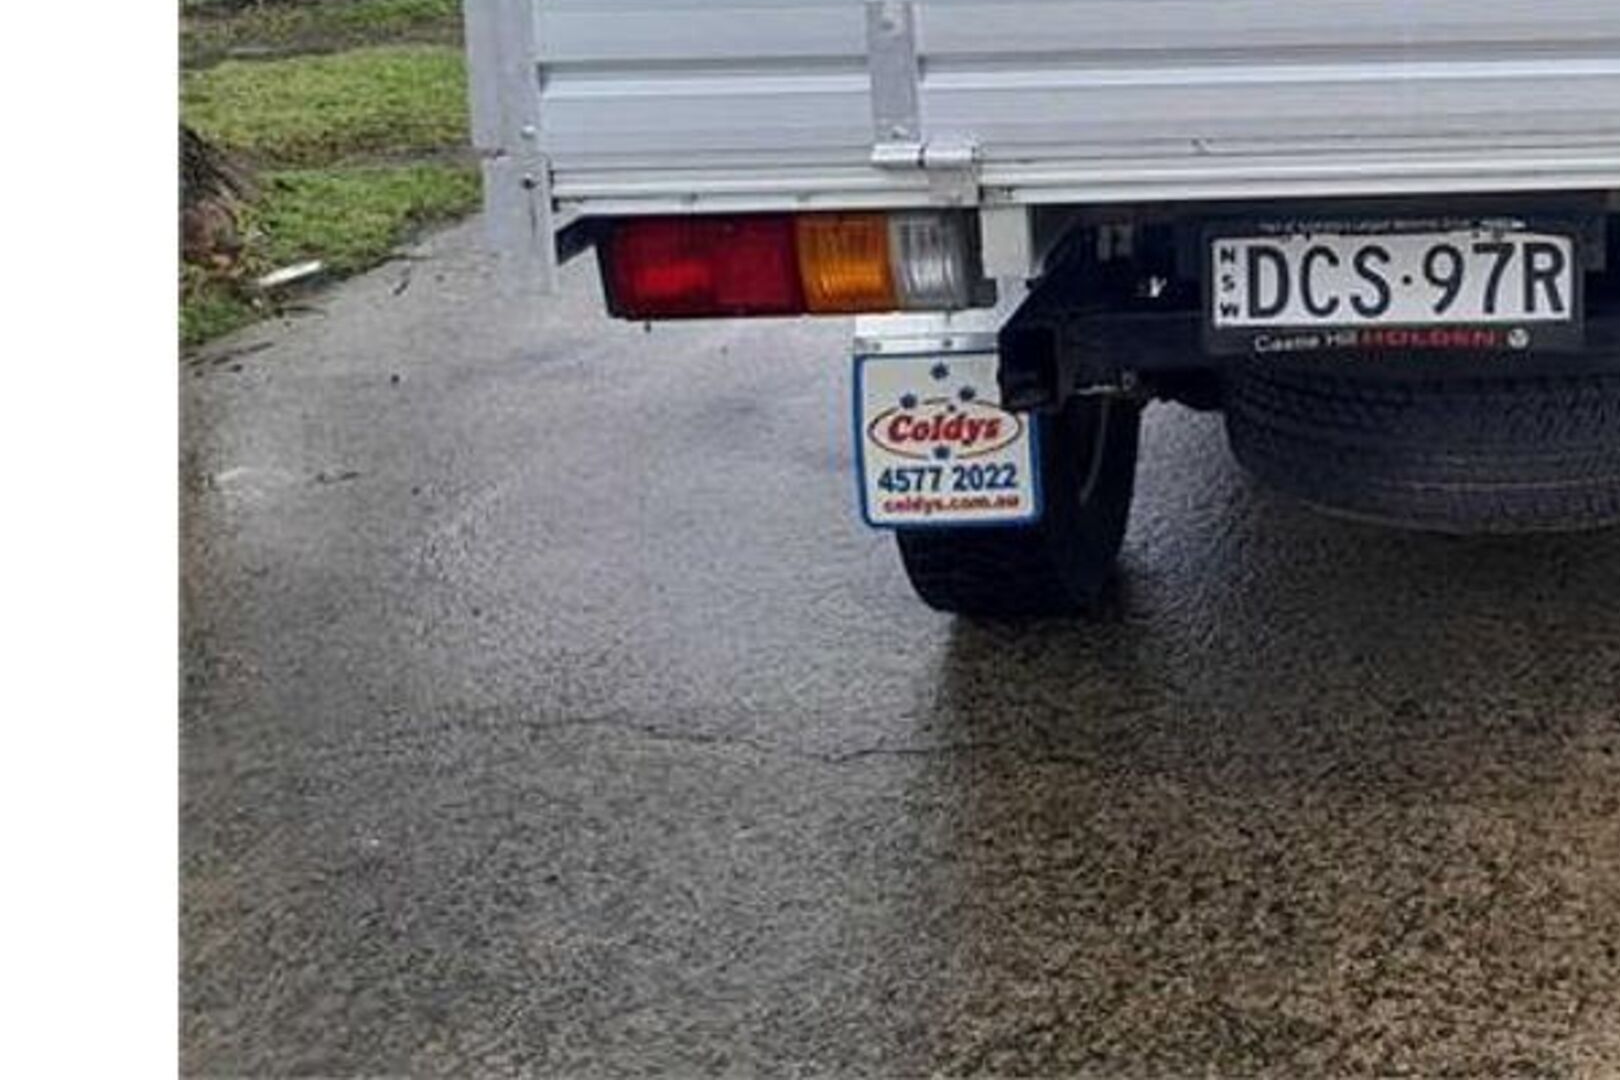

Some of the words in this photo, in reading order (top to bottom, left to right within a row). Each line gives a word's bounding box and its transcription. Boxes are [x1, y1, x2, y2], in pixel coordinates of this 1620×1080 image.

[887, 413, 1004, 446] Coldys
[877, 467, 942, 493] 4577
[952, 462, 1019, 491] 2022
[882, 494, 1020, 515] coldys.com.au
